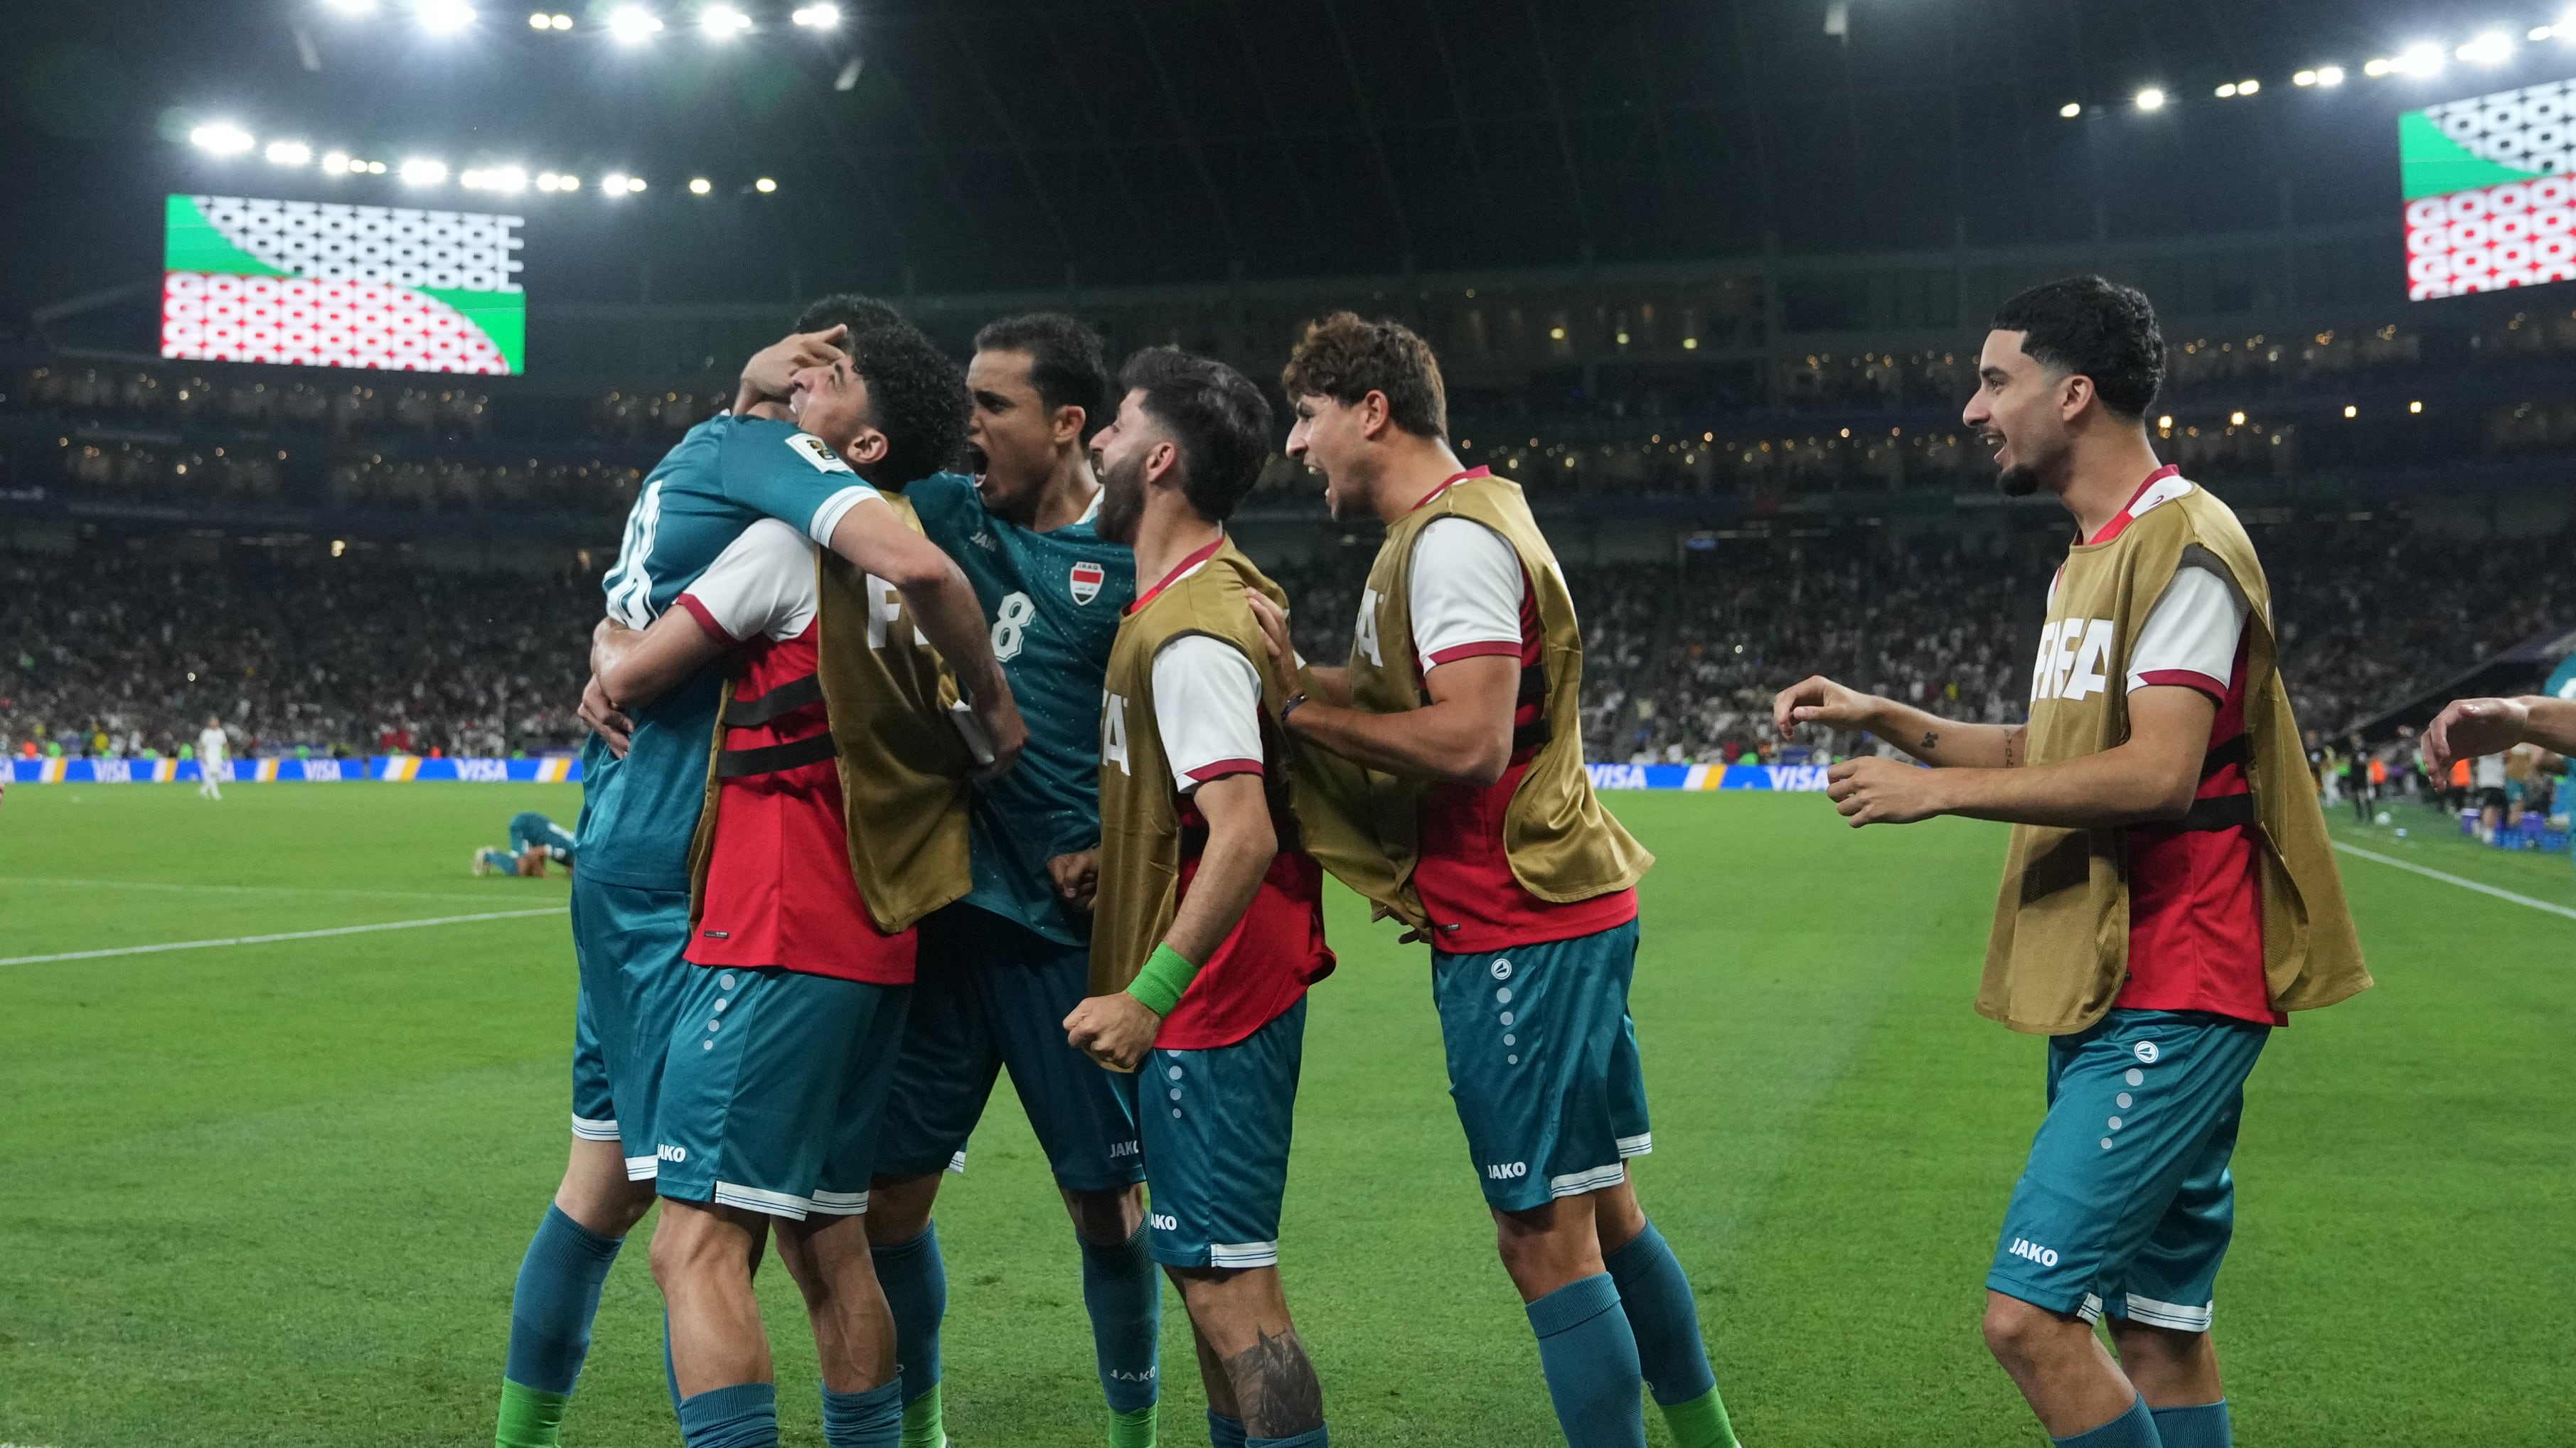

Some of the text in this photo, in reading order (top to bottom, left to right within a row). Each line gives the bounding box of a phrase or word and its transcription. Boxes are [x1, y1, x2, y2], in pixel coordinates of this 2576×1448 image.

[990, 591, 1035, 663] 8
[2031, 618, 2114, 702] FIFA
[454, 758, 508, 782] VISA
[1585, 764, 1647, 790] VISA
[1765, 765, 1829, 791] VISA
[658, 1143, 686, 1163] AKO
[1487, 1162, 1527, 1179] JAKO
[1150, 1212, 1177, 1230] AKO
[2009, 1238, 2058, 1267] JAKO
[1110, 1365, 1155, 1381] JAKO
